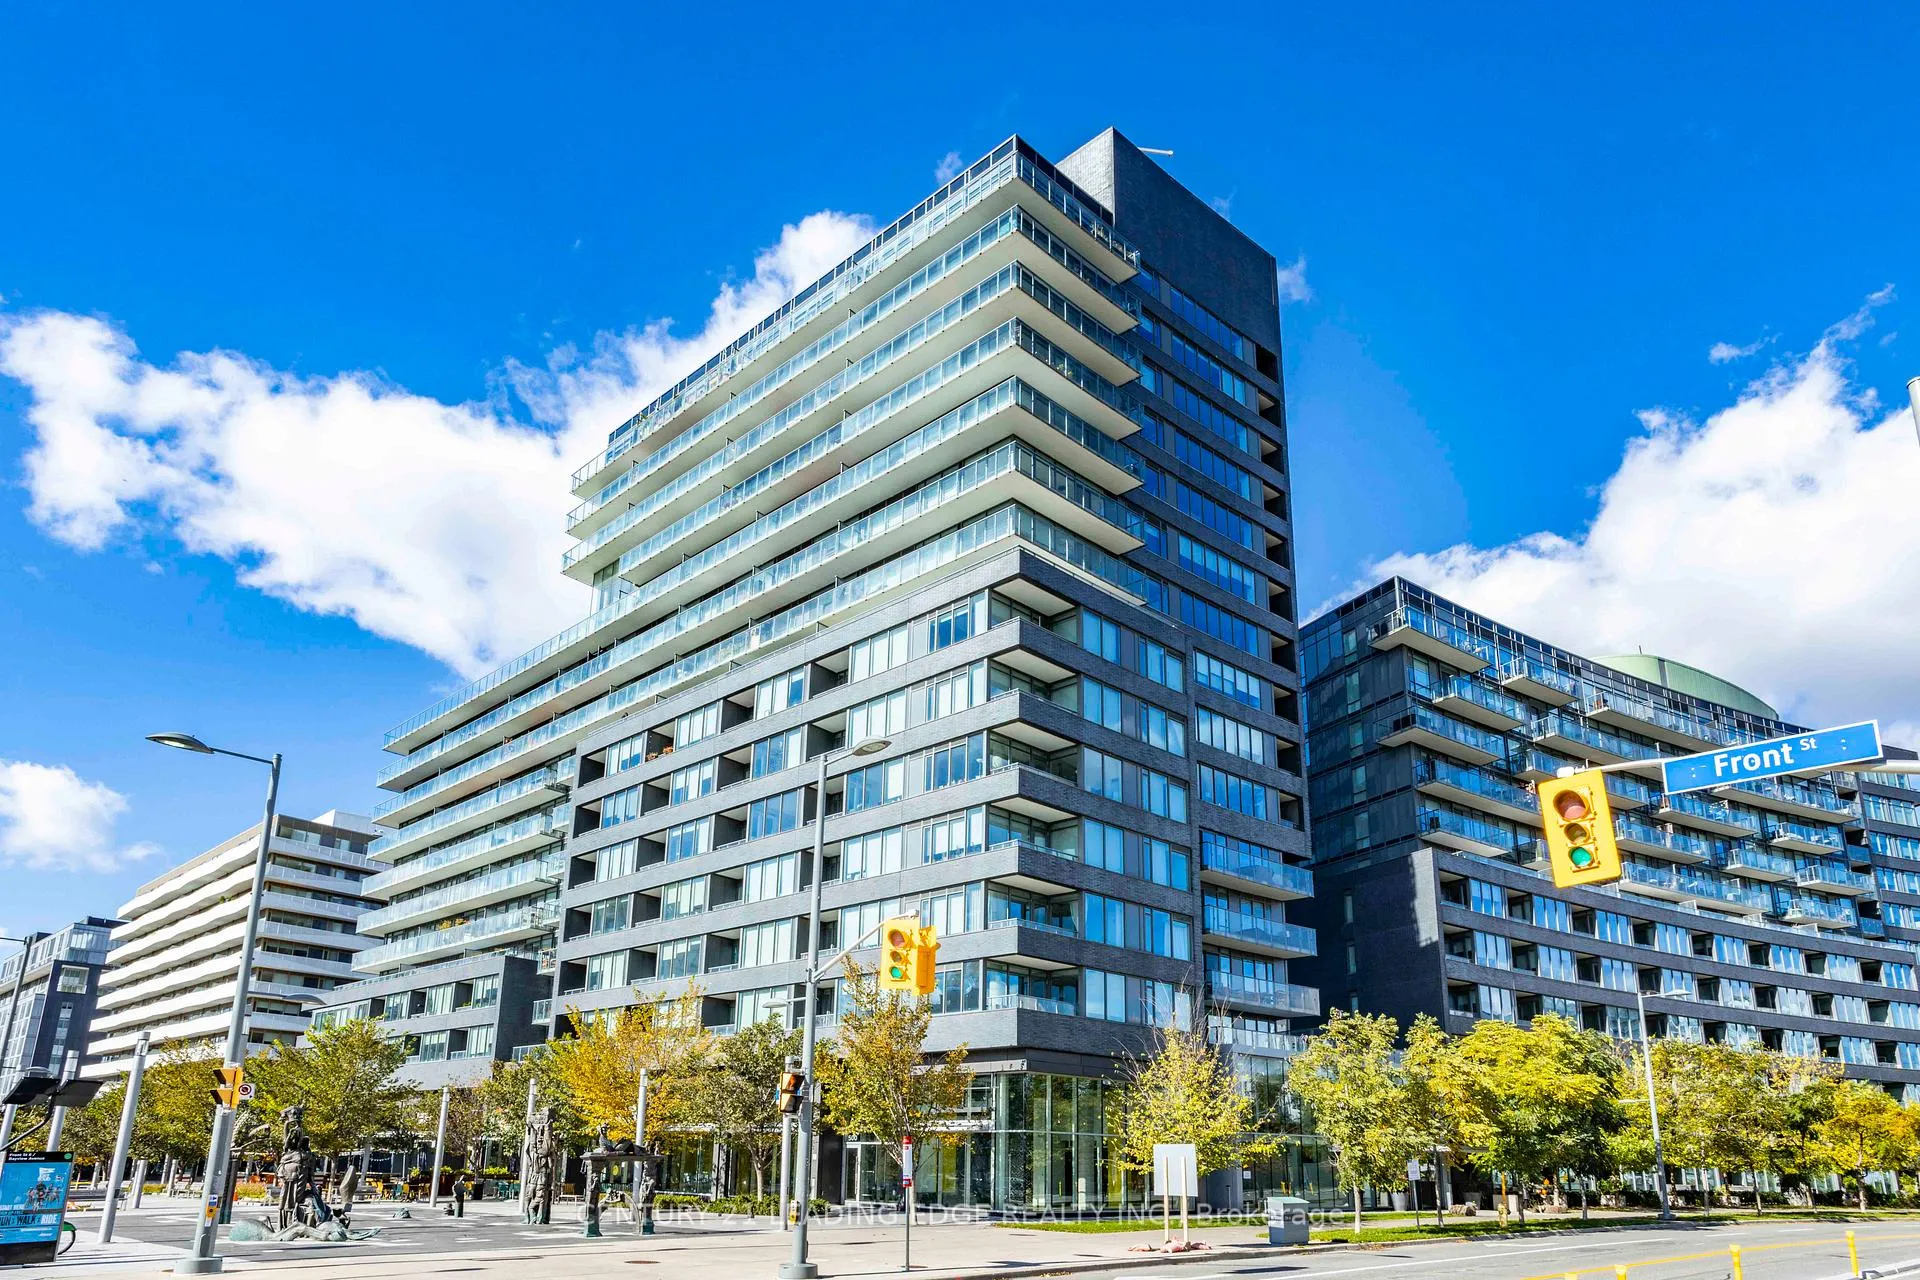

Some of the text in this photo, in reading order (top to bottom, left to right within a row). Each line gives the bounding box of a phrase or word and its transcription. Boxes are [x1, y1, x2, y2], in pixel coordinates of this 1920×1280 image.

[1713, 737, 1818, 777] Front St
[17, 1215, 36, 1225] WALK
[41, 1214, 57, 1224] RIDE
